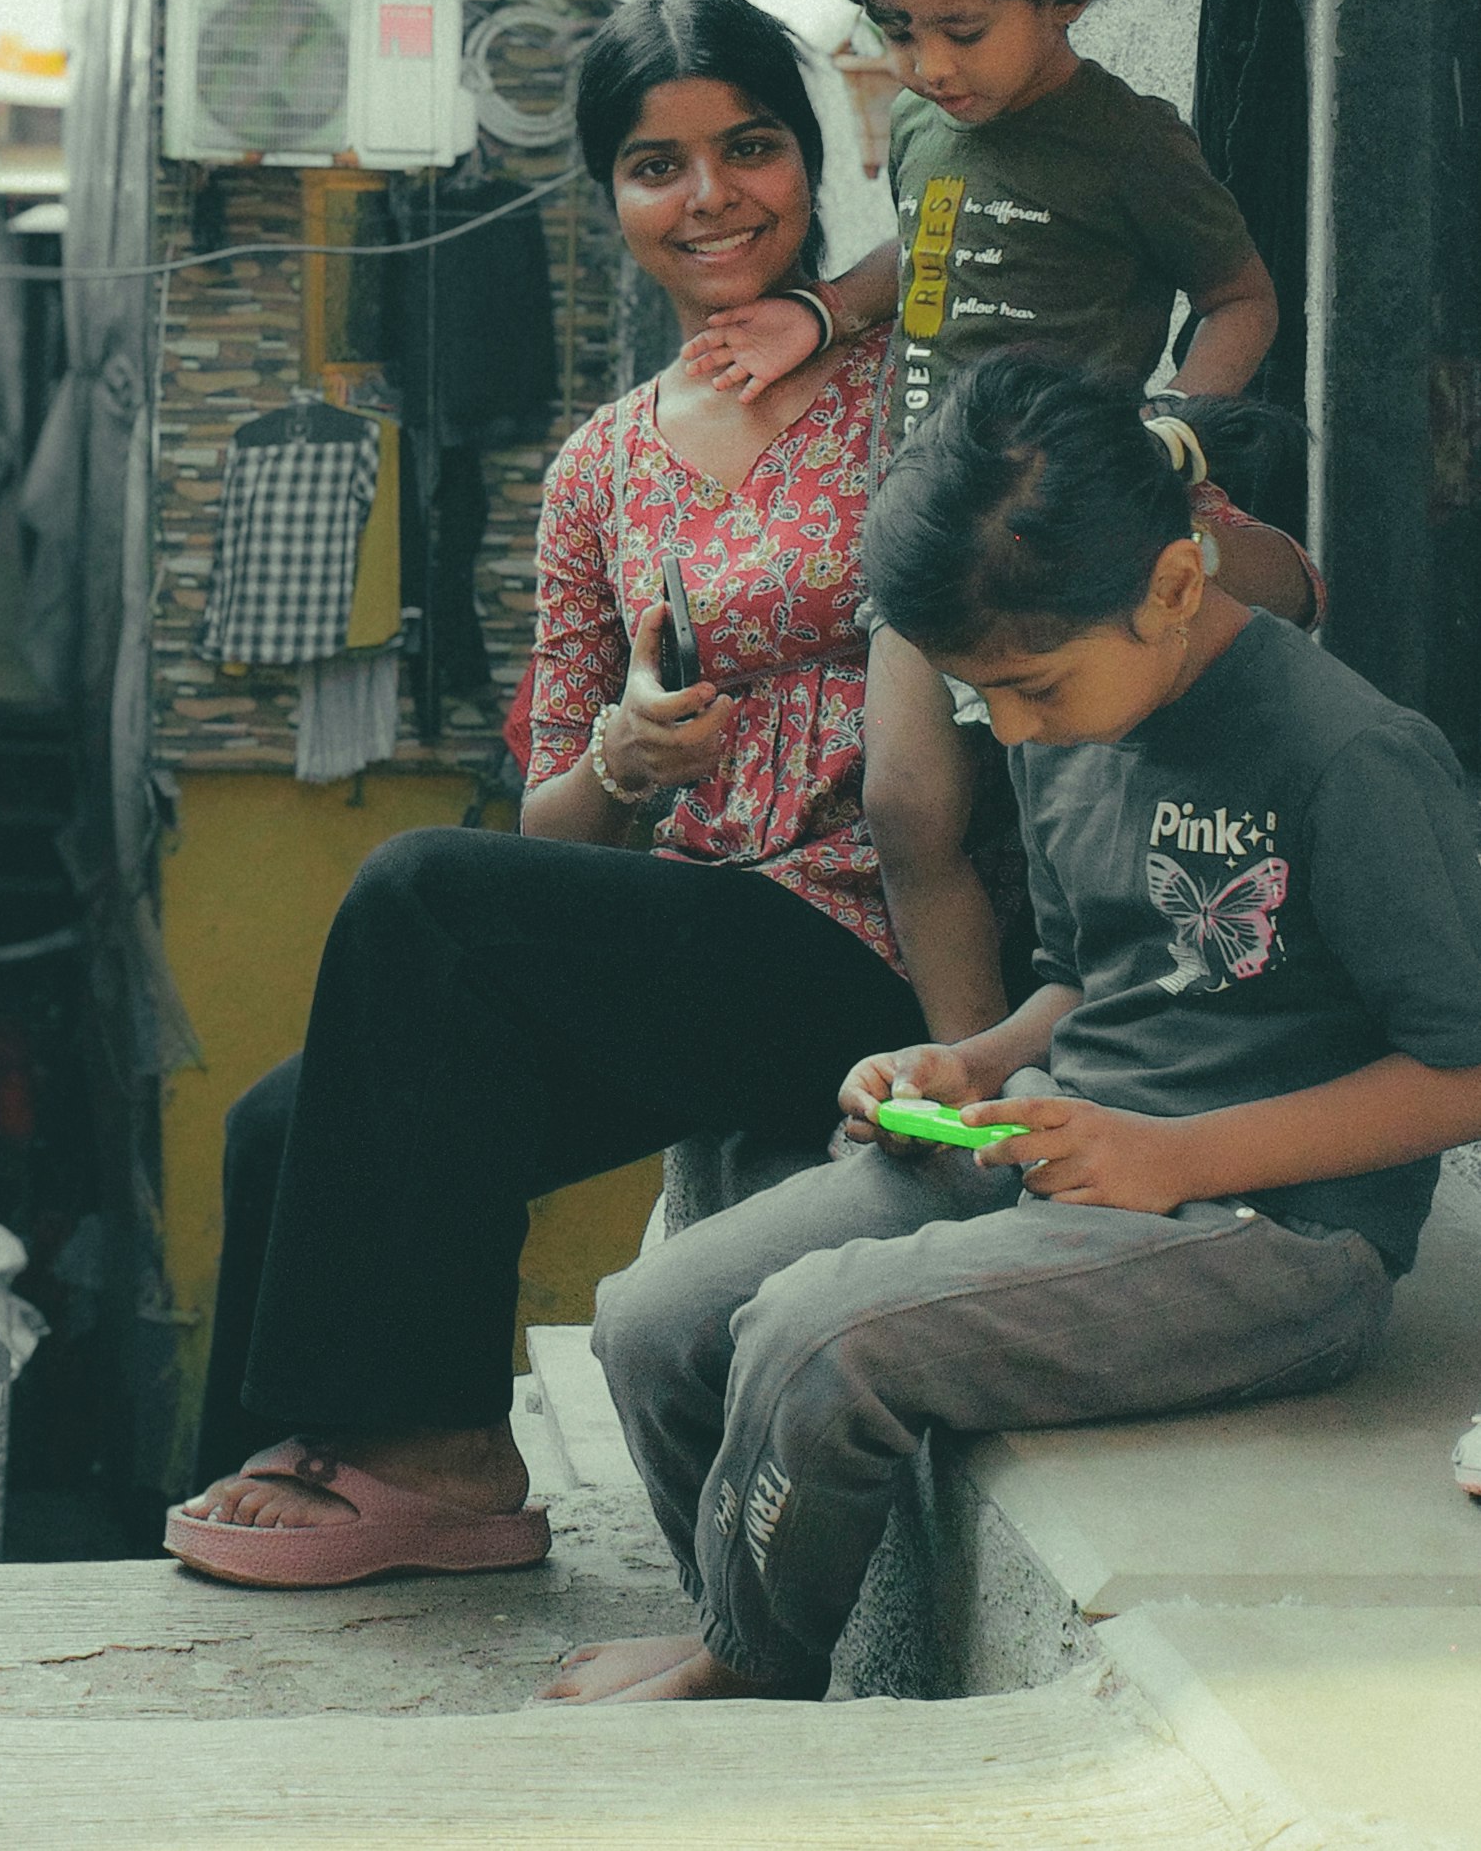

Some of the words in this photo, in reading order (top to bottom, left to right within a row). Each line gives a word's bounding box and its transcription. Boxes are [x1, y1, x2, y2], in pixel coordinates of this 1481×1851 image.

[963, 197, 983, 215] be
[983, 200, 1051, 225] different
[915, 196, 952, 307] RULES
[955, 249, 974, 267] go
[974, 248, 1003, 265] wild
[951, 296, 998, 320] follow
[1149, 801, 1247, 855] Pink
